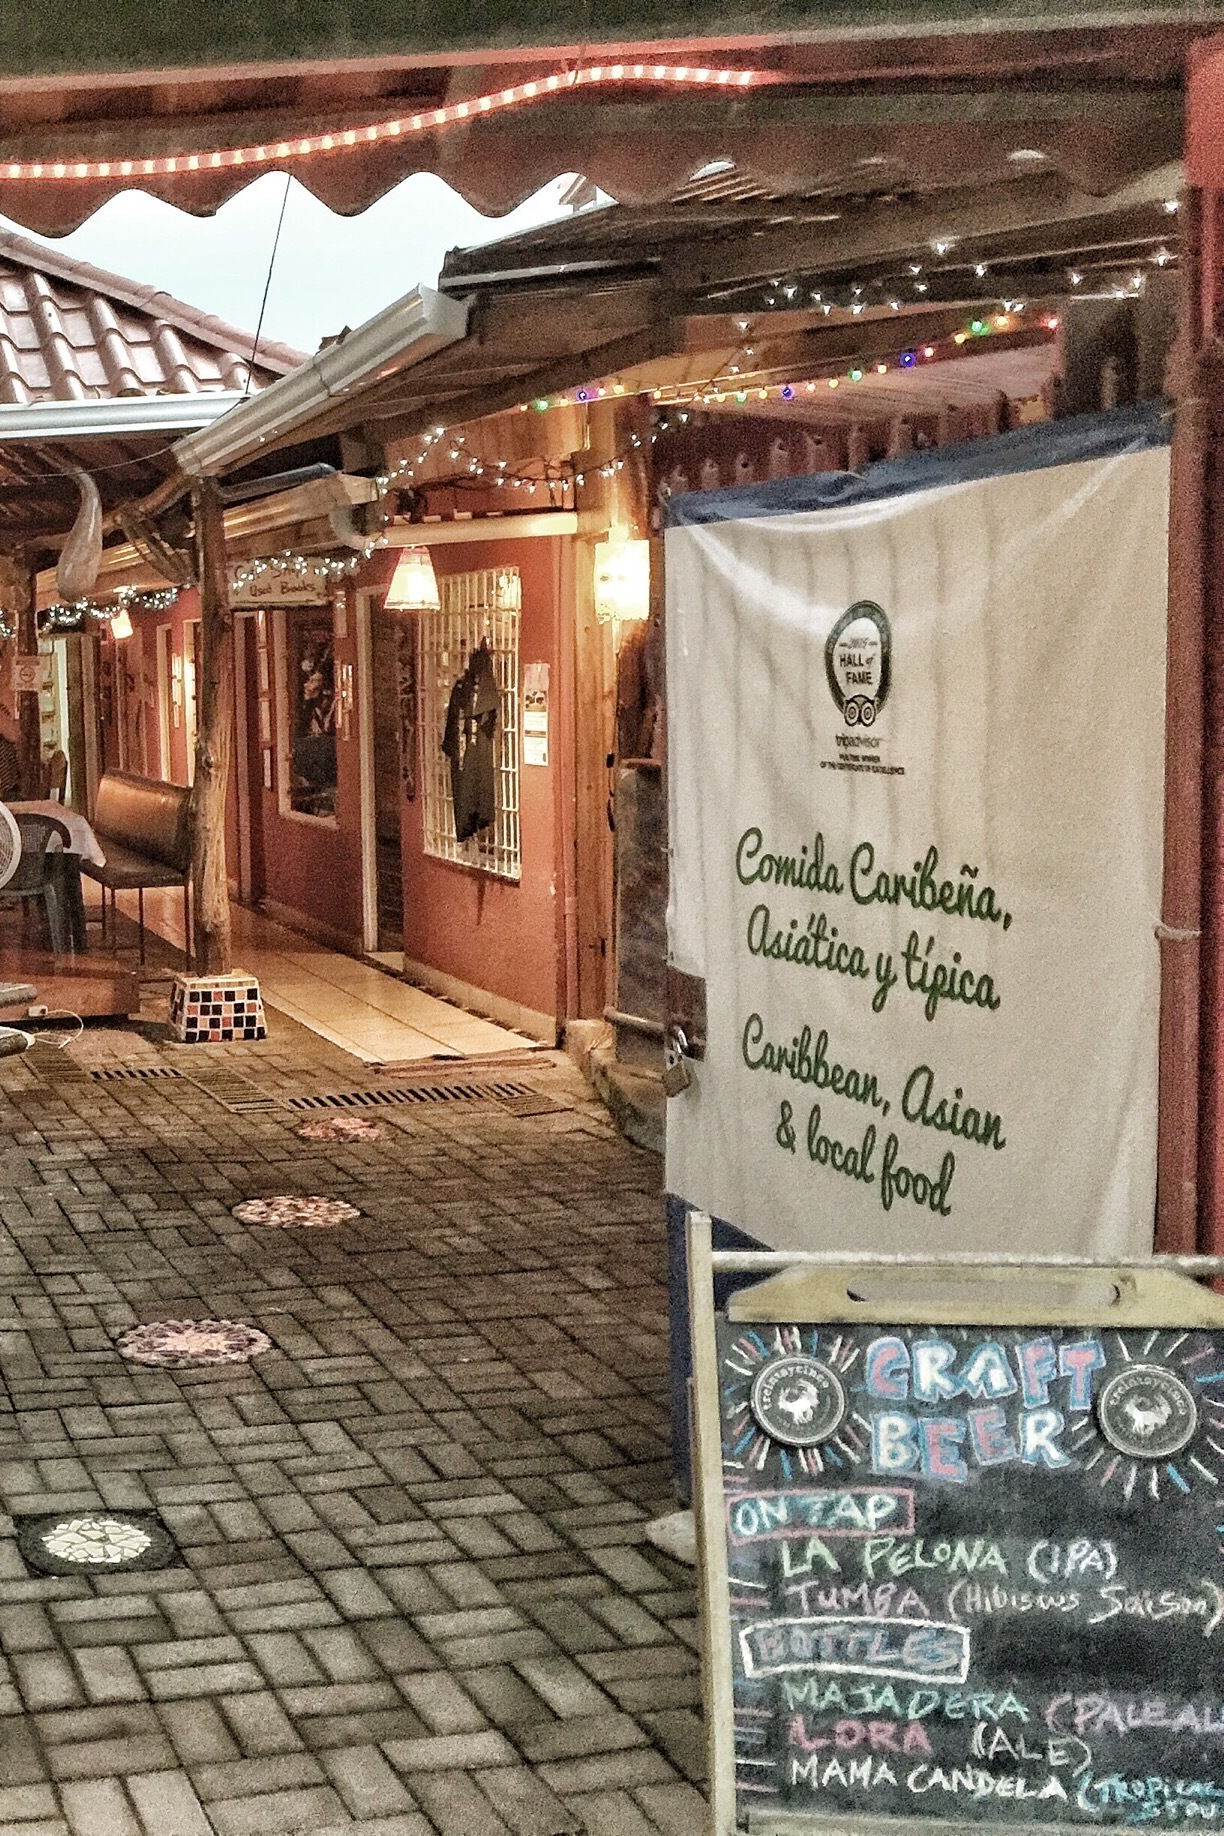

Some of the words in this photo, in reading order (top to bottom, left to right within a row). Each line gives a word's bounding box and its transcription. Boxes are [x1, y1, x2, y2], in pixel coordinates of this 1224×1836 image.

[280, 579, 316, 595] Books
[839, 652, 864, 668] HALL
[846, 671, 873, 685] FAME
[736, 827, 843, 894] Comida
[850, 842, 1013, 931] Caribeña,
[747, 904, 870, 978] Asiática
[872, 951, 897, 1013] y
[901, 931, 1001, 1022] típica
[742, 1013, 891, 1116] Caribbean,
[901, 1065, 1006, 1151] Asian
[776, 1100, 797, 1154] &
[807, 1104, 875, 1183] local
[881, 1133, 956, 1217] food
[865, 1335, 1105, 1411] CRAFT
[871, 1405, 1071, 1482] BEER
[736, 1496, 789, 1536] ON
[804, 1493, 897, 1531] TAP
[782, 1536, 841, 1578] LA
[863, 1536, 1007, 1579] PELONA
[1027, 1539, 1119, 1585] (IPA)
[784, 1580, 931, 1616] TUMBA
[753, 1625, 964, 1671] BOTTLES
[783, 1677, 1030, 1723] MAJADERA
[789, 1714, 934, 1754] LORA
[972, 1721, 1092, 1778] (ALE)
[791, 1754, 898, 1791] MAMA
[907, 1762, 1068, 1801] CANDELA
